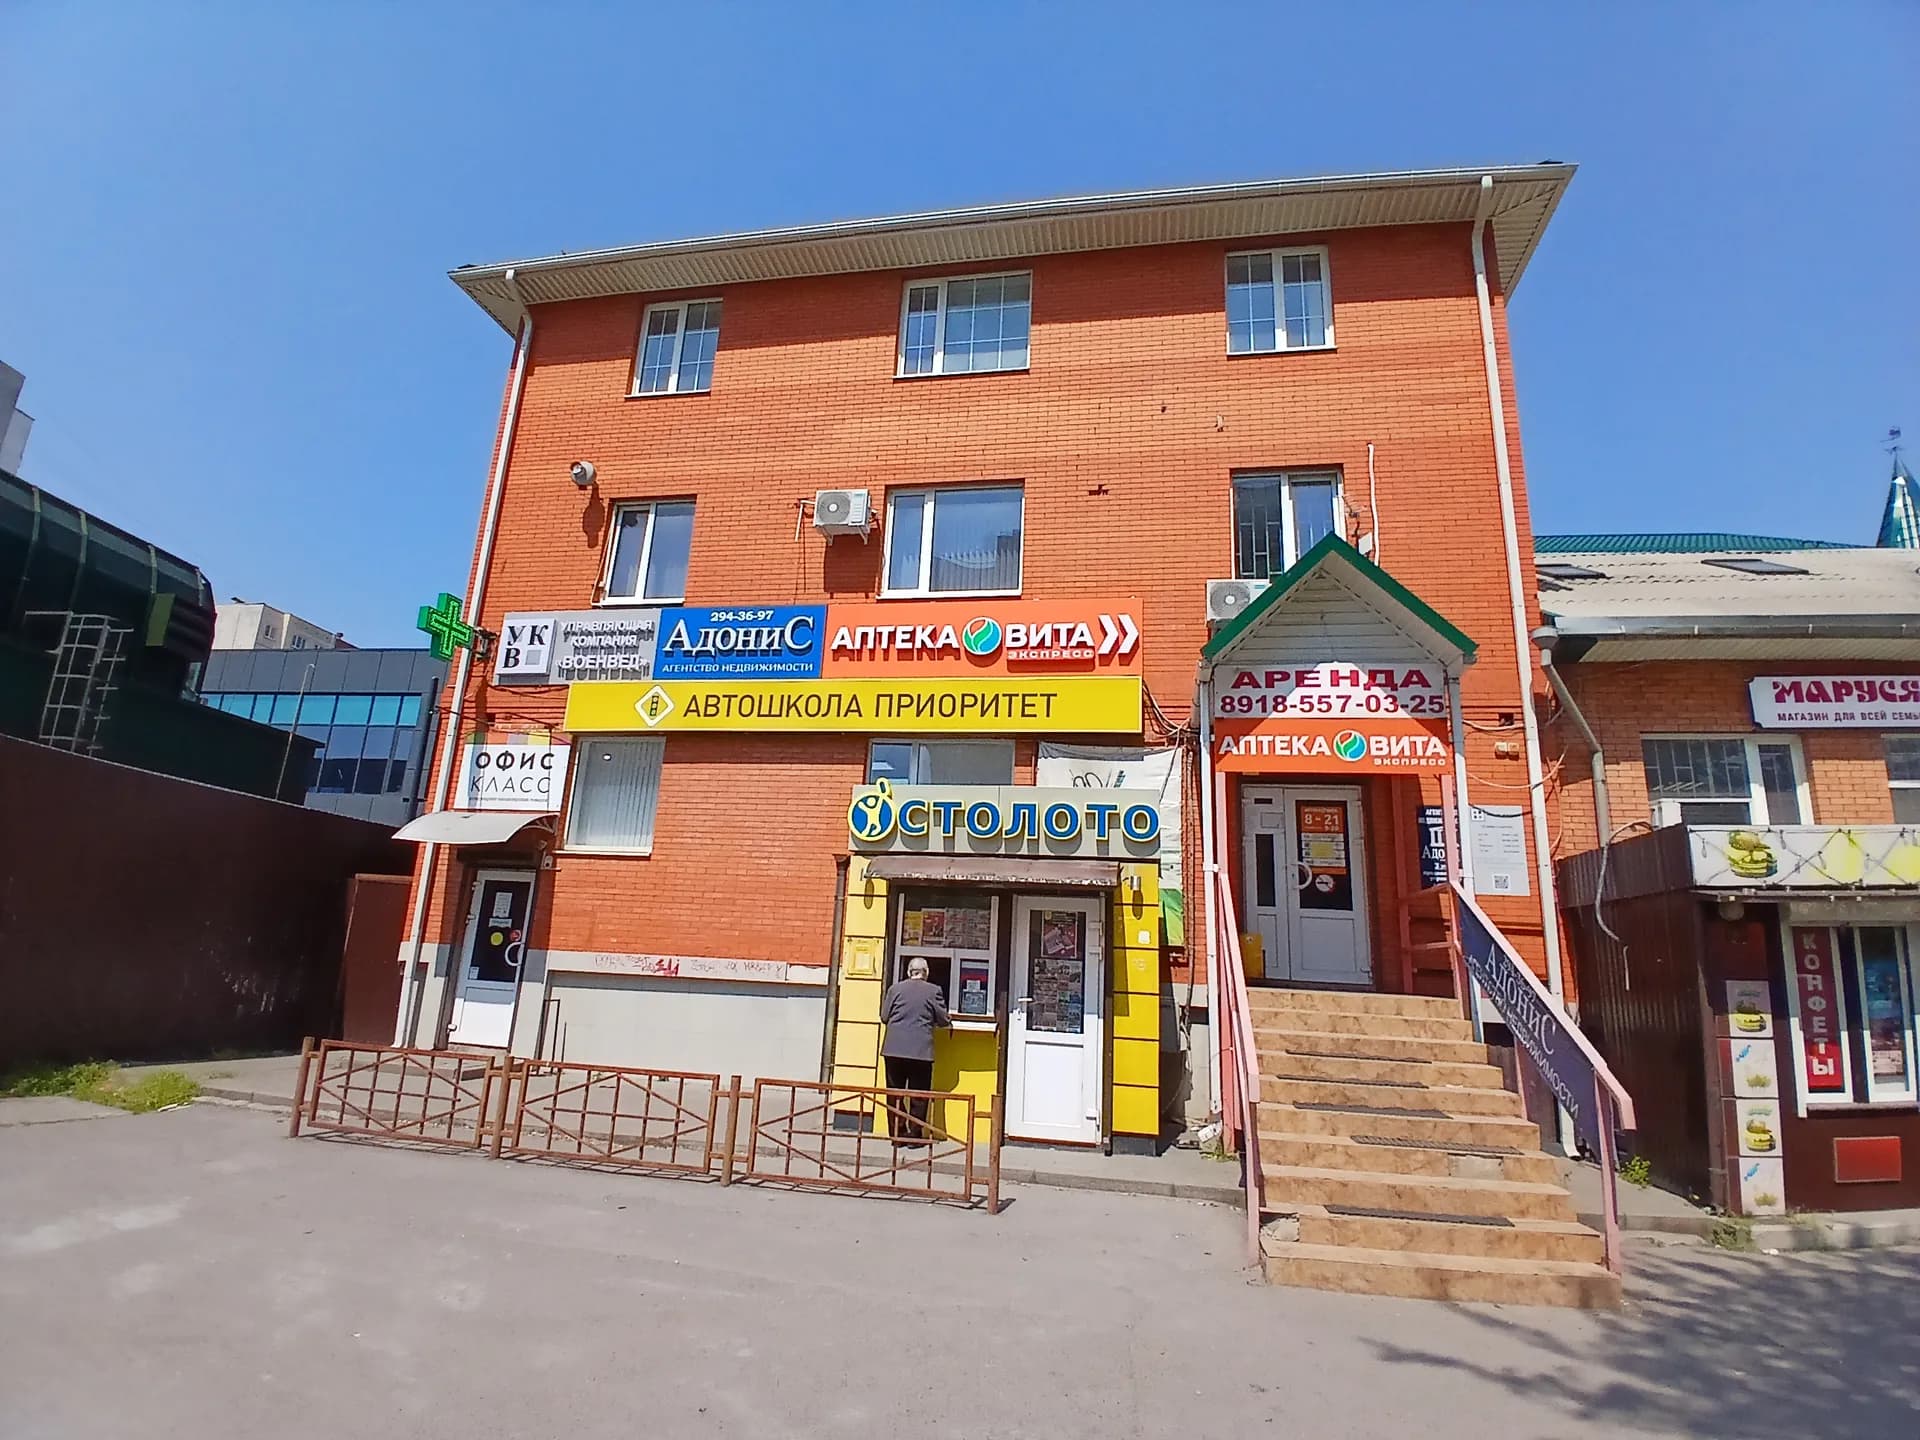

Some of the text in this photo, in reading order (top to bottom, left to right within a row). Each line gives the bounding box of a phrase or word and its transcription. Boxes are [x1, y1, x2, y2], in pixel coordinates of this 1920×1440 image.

[710, 610, 774, 622] 294-36-97
[561, 620, 653, 631] УПРАВЛЯЮЩАЯ
[571, 635, 638, 646] КОМПАНИЯ
[831, 623, 1095, 650] АПТЕКА ВИТА
[1008, 650, 1094, 659] ЭКСПРЕСС
[662, 663, 813, 673] АГЕНТСТВО НЕДВИЖИМОСТИ
[1231, 669, 1432, 691] АРЕНДА
[1772, 680, 1920, 703] МАРУСЯ
[683, 693, 1058, 718] АВТОШКОЛА ПРИОРИТЕТ
[1220, 694, 1445, 714] 8918-557-03-25
[1777, 710, 1920, 722] МАГАЗИН ДЛЯ ВСЕЙ СЕМЬ
[1218, 735, 1447, 756] АПТЕКА ВИТА
[475, 750, 555, 772] ОФИС
[1373, 758, 1446, 766] ЭКСПРЕСС
[470, 776, 551, 794] КЛАСС
[896, 799, 1161, 842] СТОЛОТО
[1324, 814, 1339, 825] 21
